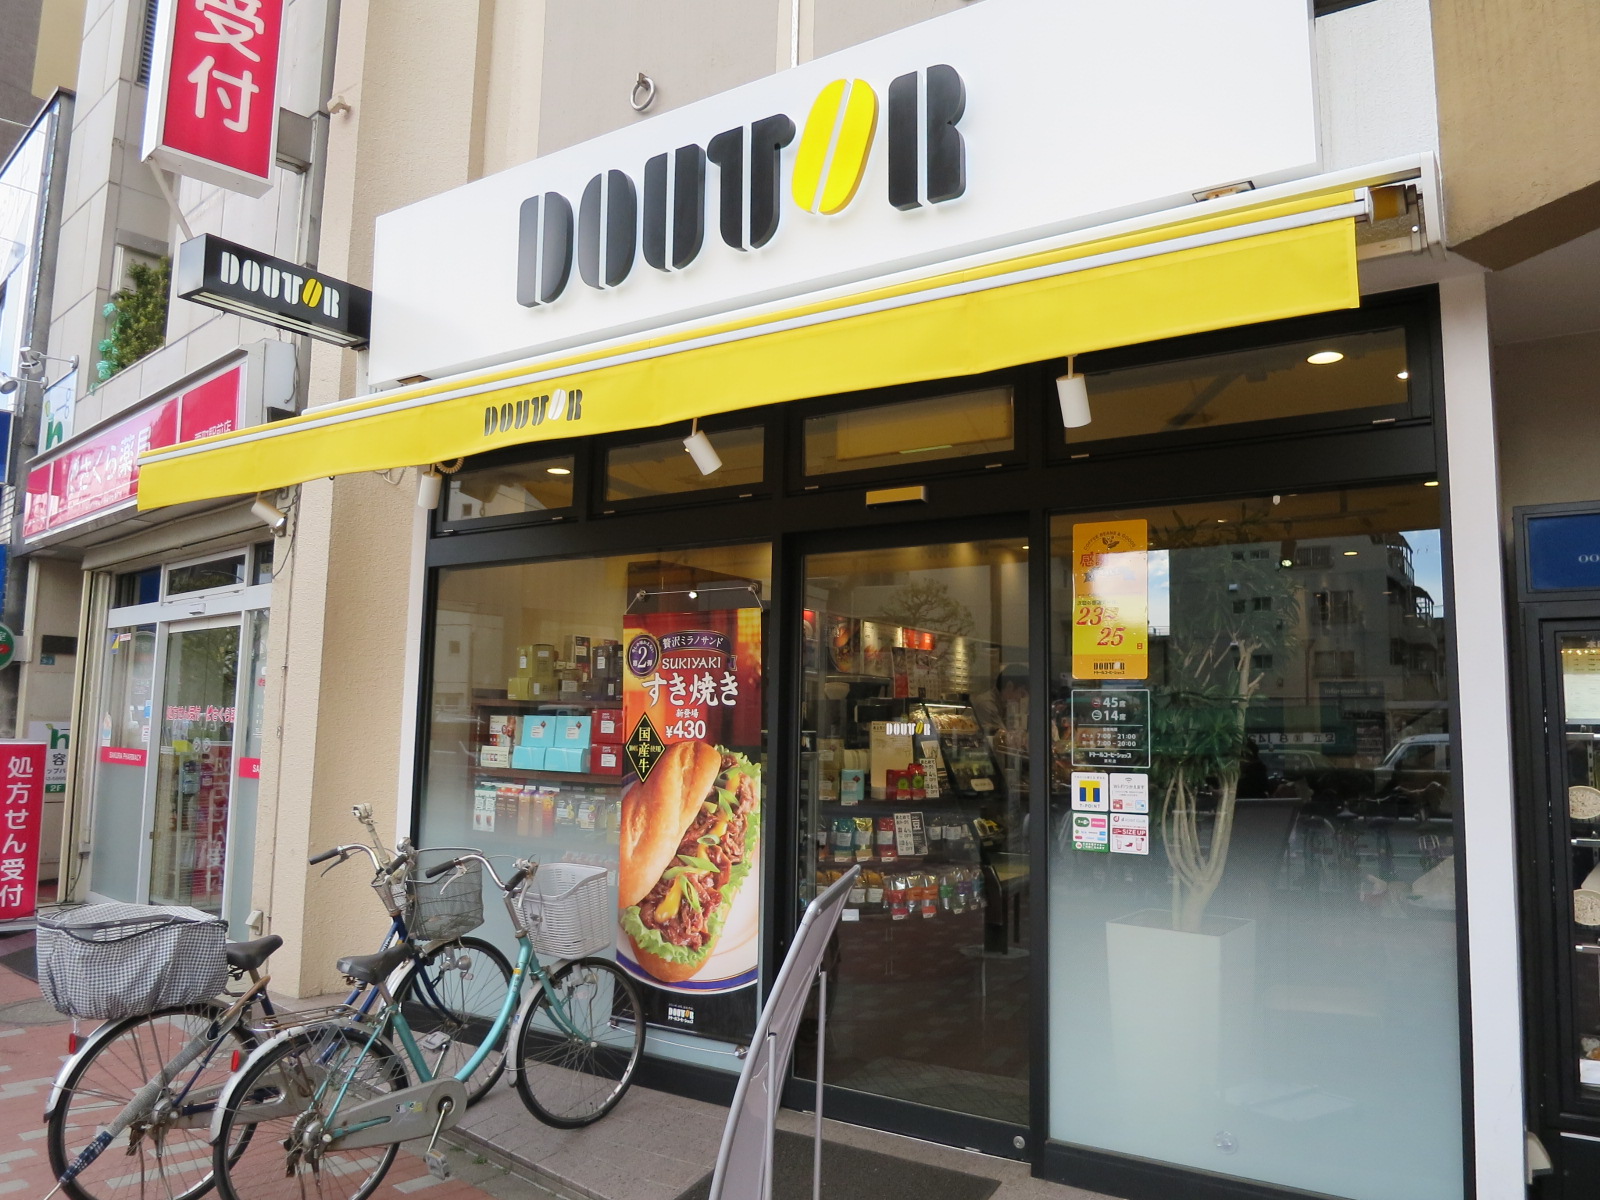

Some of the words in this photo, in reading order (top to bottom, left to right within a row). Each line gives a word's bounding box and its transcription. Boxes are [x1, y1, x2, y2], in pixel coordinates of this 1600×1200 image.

[516, 63, 967, 308] DOUTOR
[220, 251, 340, 319] DOUTOR
[484, 388, 583, 436] DOUTOR
[1076, 607, 1103, 626] 23
[662, 635, 724, 649] 贅沢ミラノサンド
[1097, 627, 1126, 646] 25
[662, 656, 721, 669] SUKIYAKI
[641, 671, 739, 707] すき焼き
[675, 708, 699, 718] 新登場
[665, 720, 706, 739] ¥430
[886, 721, 931, 735] DOUTOR
[638, 726, 651, 773] 国産牛
[50, 784, 62, 792] 2F
[0, 756, 33, 907] 処方せん受付
[668, 1006, 694, 1019] DOUTOR
